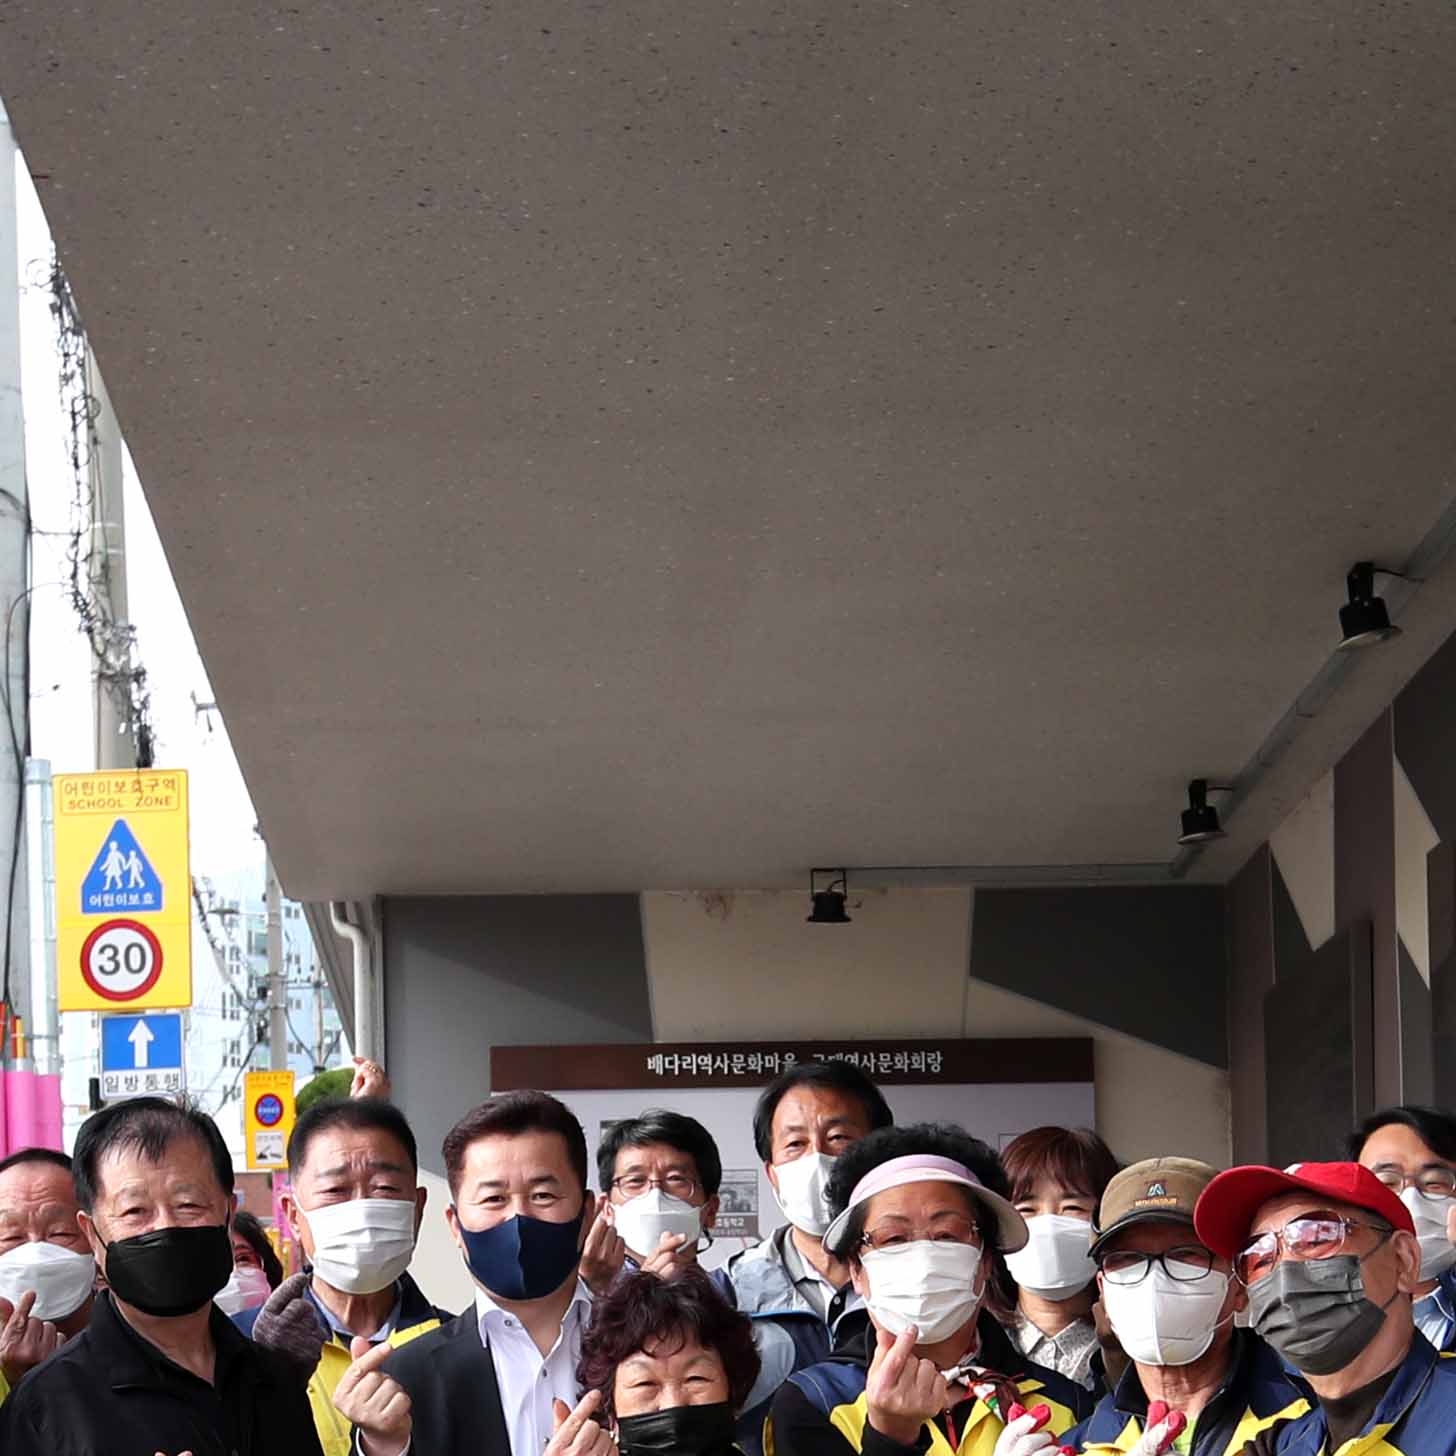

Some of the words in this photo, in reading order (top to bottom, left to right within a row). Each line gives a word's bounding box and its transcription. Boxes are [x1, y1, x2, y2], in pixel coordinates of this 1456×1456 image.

[63, 777, 177, 797] 어린이보호구역
[68, 798, 124, 810] SCHOOL
[135, 795, 173, 807] ZONE
[89, 893, 155, 908] 어린이보호
[97, 942, 146, 977] 30
[647, 1053, 798, 1076] 배다리역사문화마을
[812, 1051, 944, 1074] 역사문화회랑
[104, 1075, 182, 1096] 일방통행
